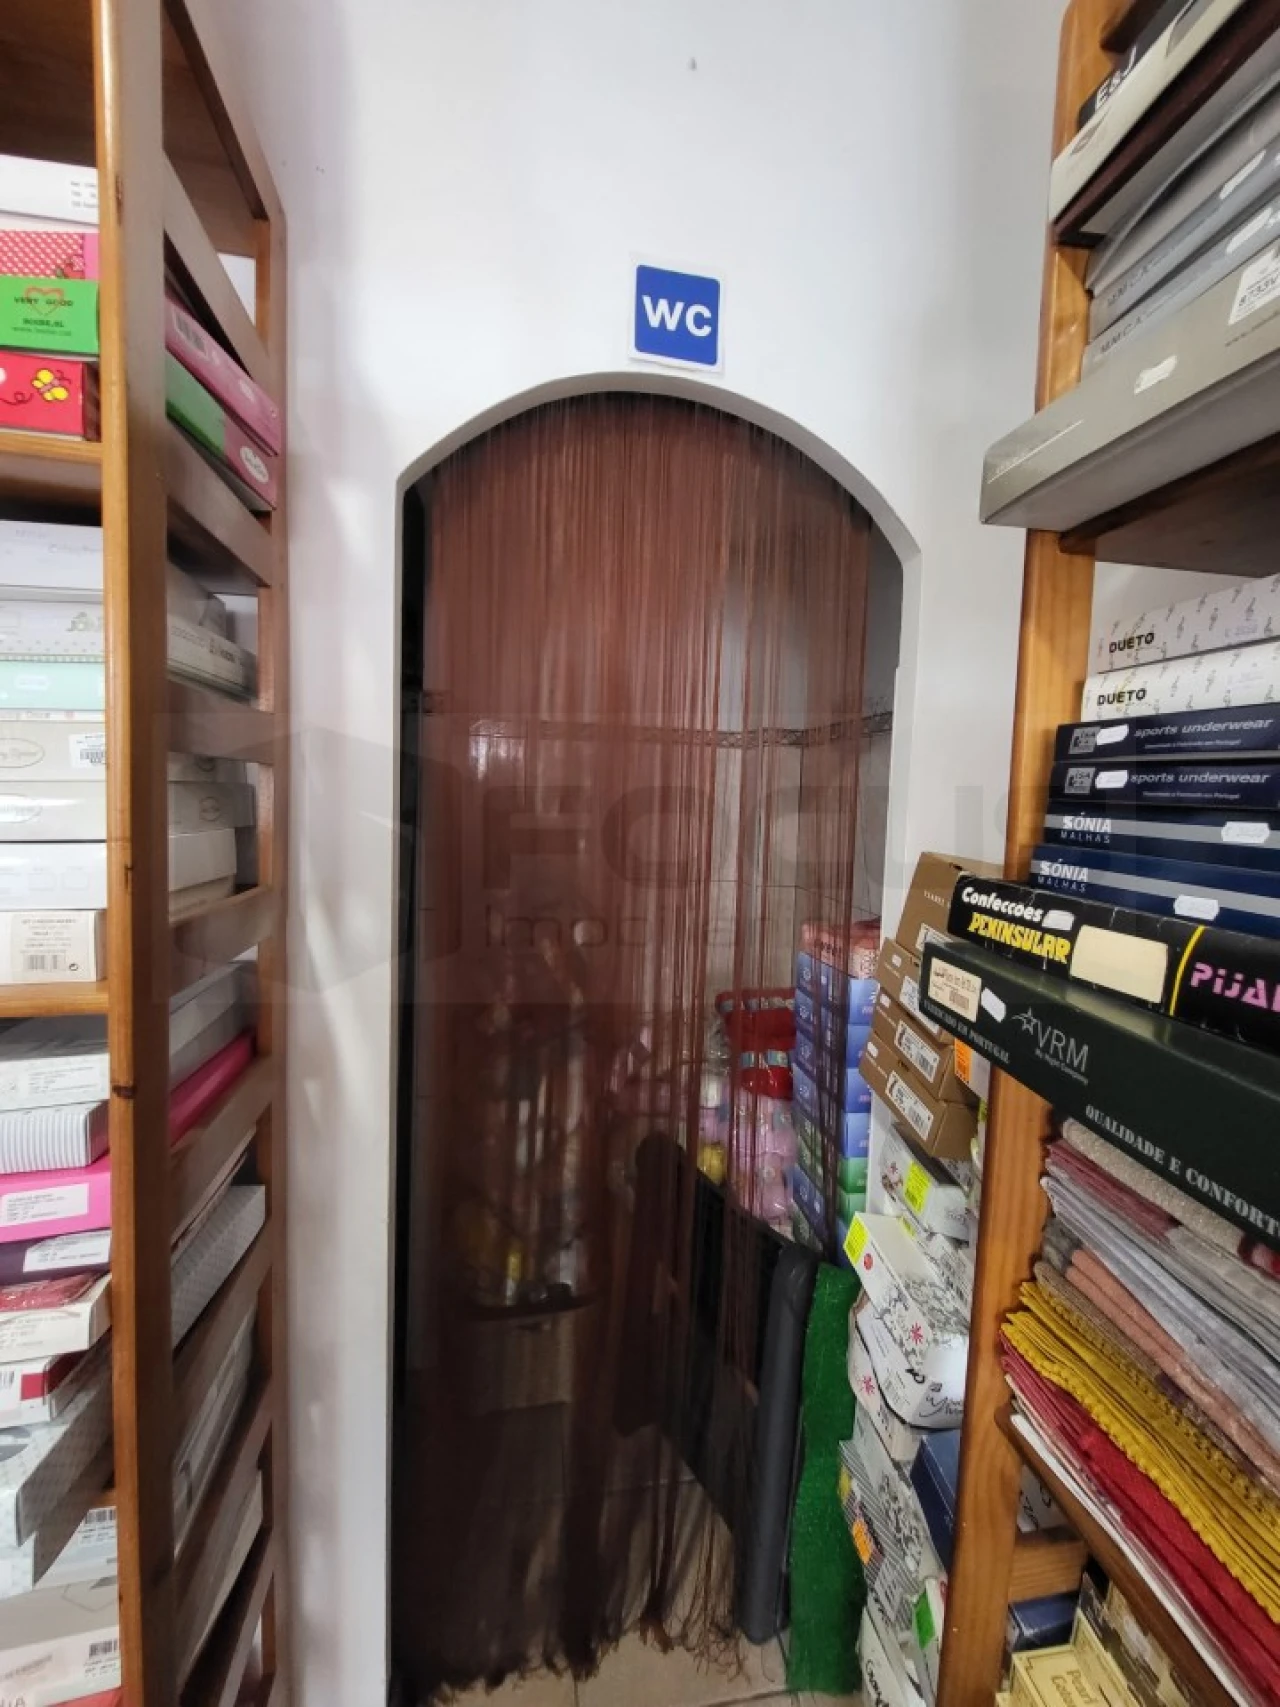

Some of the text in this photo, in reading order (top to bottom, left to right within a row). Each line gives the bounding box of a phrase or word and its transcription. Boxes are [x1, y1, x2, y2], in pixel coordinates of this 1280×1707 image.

[13, 296, 74, 307] VERY GOOD
[642, 294, 712, 337] WC
[1108, 632, 1155, 654] DUETO
[1096, 688, 1147, 707] DUETO
[1134, 718, 1274, 739] sports underwear
[1130, 771, 1272, 785] sports underwear
[1062, 812, 1112, 833] SÓNIA
[1060, 830, 1110, 844] MALHAS
[1039, 859, 1089, 882] SÓNIA
[1037, 876, 1086, 893] MALHAS
[967, 912, 1071, 964] PENINSULAR
[1037, 1019, 1089, 1073] VRM
[1085, 1104, 1280, 1238] QUALIDADE E CONFORT
